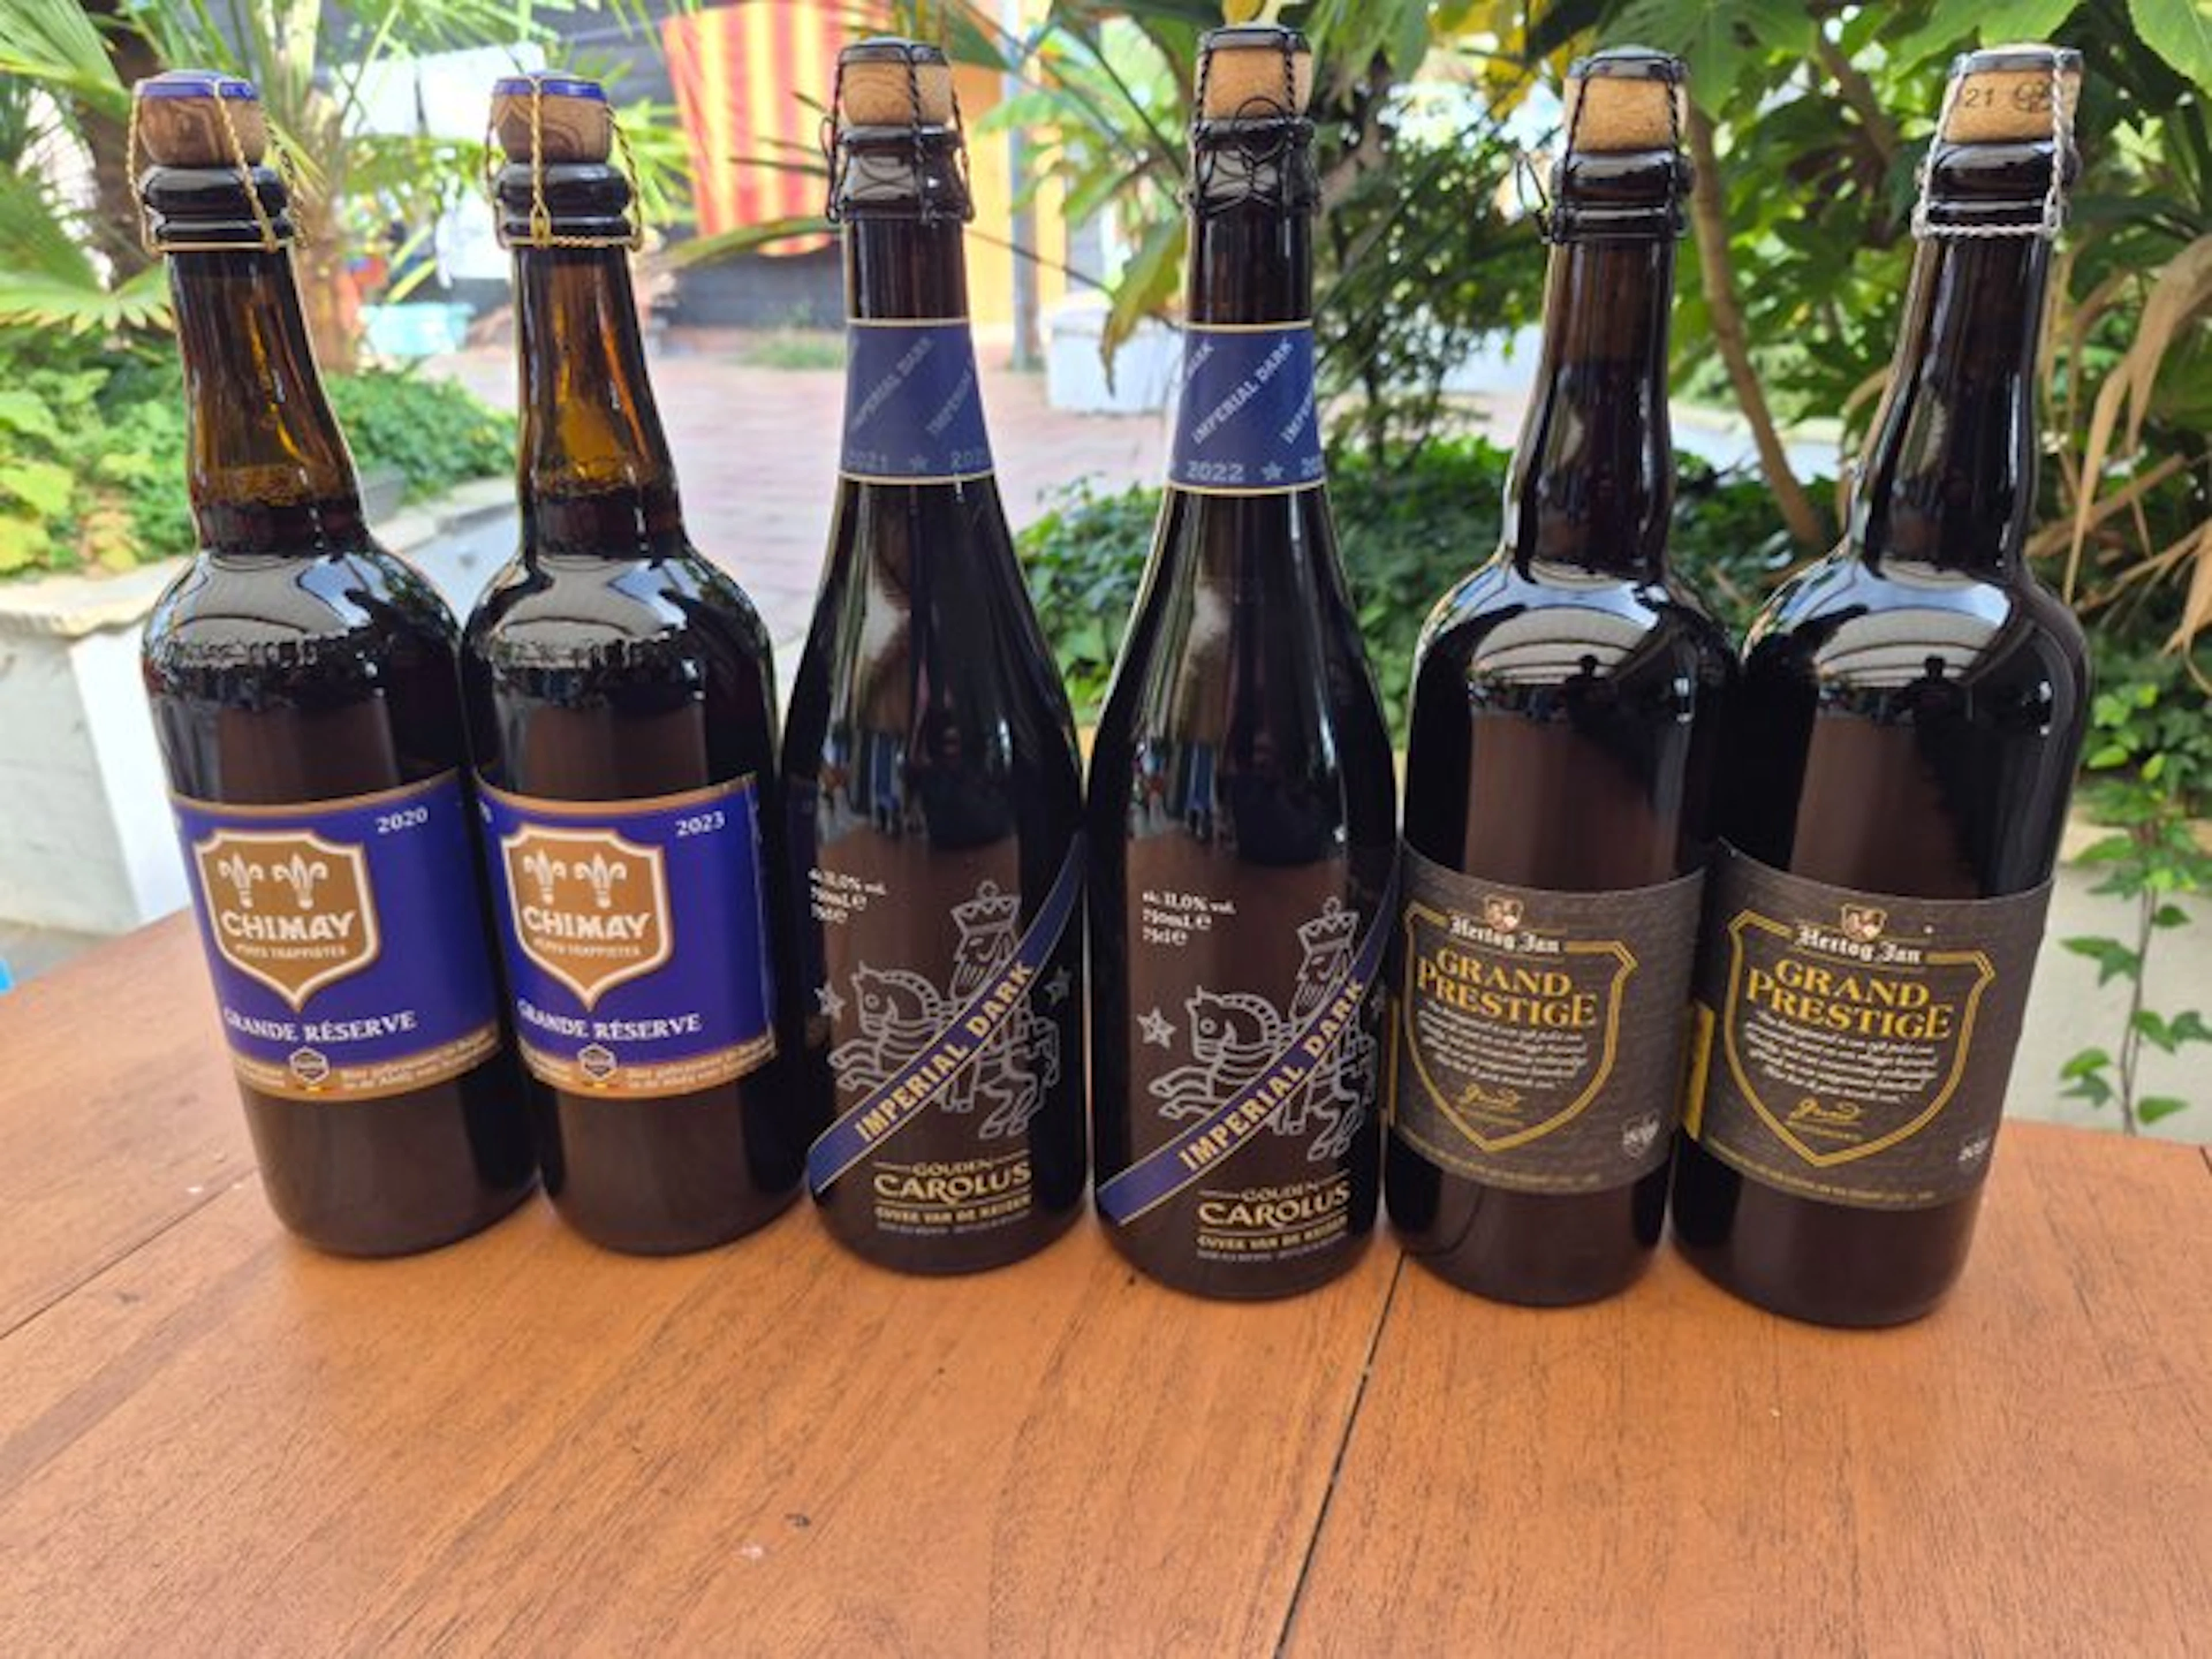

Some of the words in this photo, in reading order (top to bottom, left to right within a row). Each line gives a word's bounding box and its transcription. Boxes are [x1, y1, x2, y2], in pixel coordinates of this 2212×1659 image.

[1190, 380, 1262, 445] IMPERIAL
[1254, 335, 1294, 384] DARK
[1185, 461, 1244, 483] 2022
[374, 806, 429, 834] 2020
[675, 810, 726, 837] 2023
[220, 908, 357, 941] CHIMAY
[521, 905, 652, 940] CHIMAY
[1447, 913, 1516, 951] Hertog
[1518, 930, 1560, 953] Jan
[1793, 923, 1873, 962] Hertog
[1873, 940, 1922, 964] Jan
[1417, 955, 1598, 1028] PRESTIGE
[1436, 948, 1573, 998] GRAND
[1774, 959, 1930, 1007] GRAND
[224, 1006, 298, 1041] GRANDE
[304, 1009, 418, 1041] RÉSERVE
[517, 999, 589, 1037] GRANDE
[593, 1013, 702, 1041] RÉSERVE
[1746, 966, 1955, 1040] PRESTIGE
[854, 1043, 969, 1143] IMPERIAL
[965, 960, 1035, 1038] DARK
[1177, 1065, 1305, 1171] IMPERIAL
[1302, 977, 1364, 1058] DARK
[873, 1160, 1032, 1205] CAROLUS
[911, 1158, 994, 1177] GOUDEN
[1197, 1180, 1351, 1228] CAROLUS
[1240, 1181, 1320, 1203] GOUDEN
